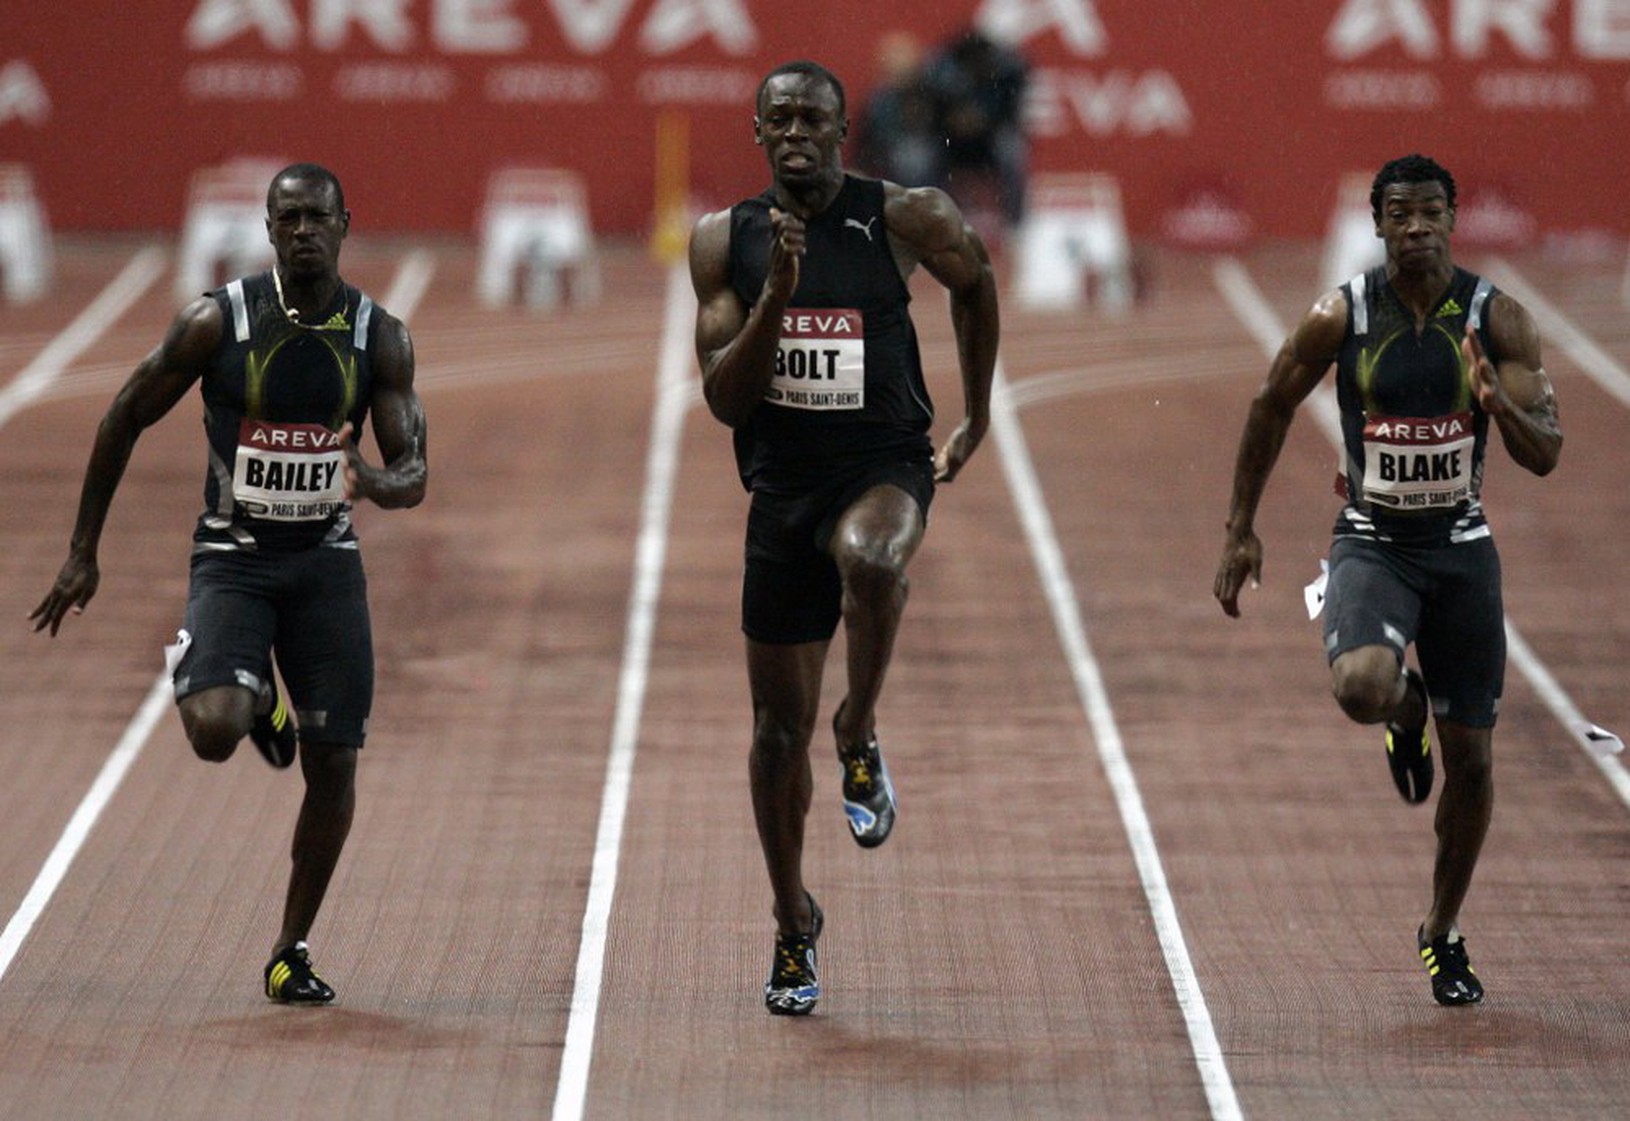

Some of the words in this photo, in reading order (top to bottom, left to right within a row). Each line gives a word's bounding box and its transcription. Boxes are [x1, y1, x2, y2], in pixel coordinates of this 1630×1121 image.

[781, 315, 852, 333] REVA
[774, 347, 840, 380] BOLT
[786, 390, 808, 405] PARIS
[810, 391, 860, 406] SAINT-DENIS
[251, 428, 340, 447] AREVA
[1375, 419, 1463, 440] AREVA
[245, 457, 339, 492] BAILEY
[1380, 449, 1461, 483] BLAKE
[1402, 493, 1426, 506] PARIS
[271, 503, 295, 517] PARIS
